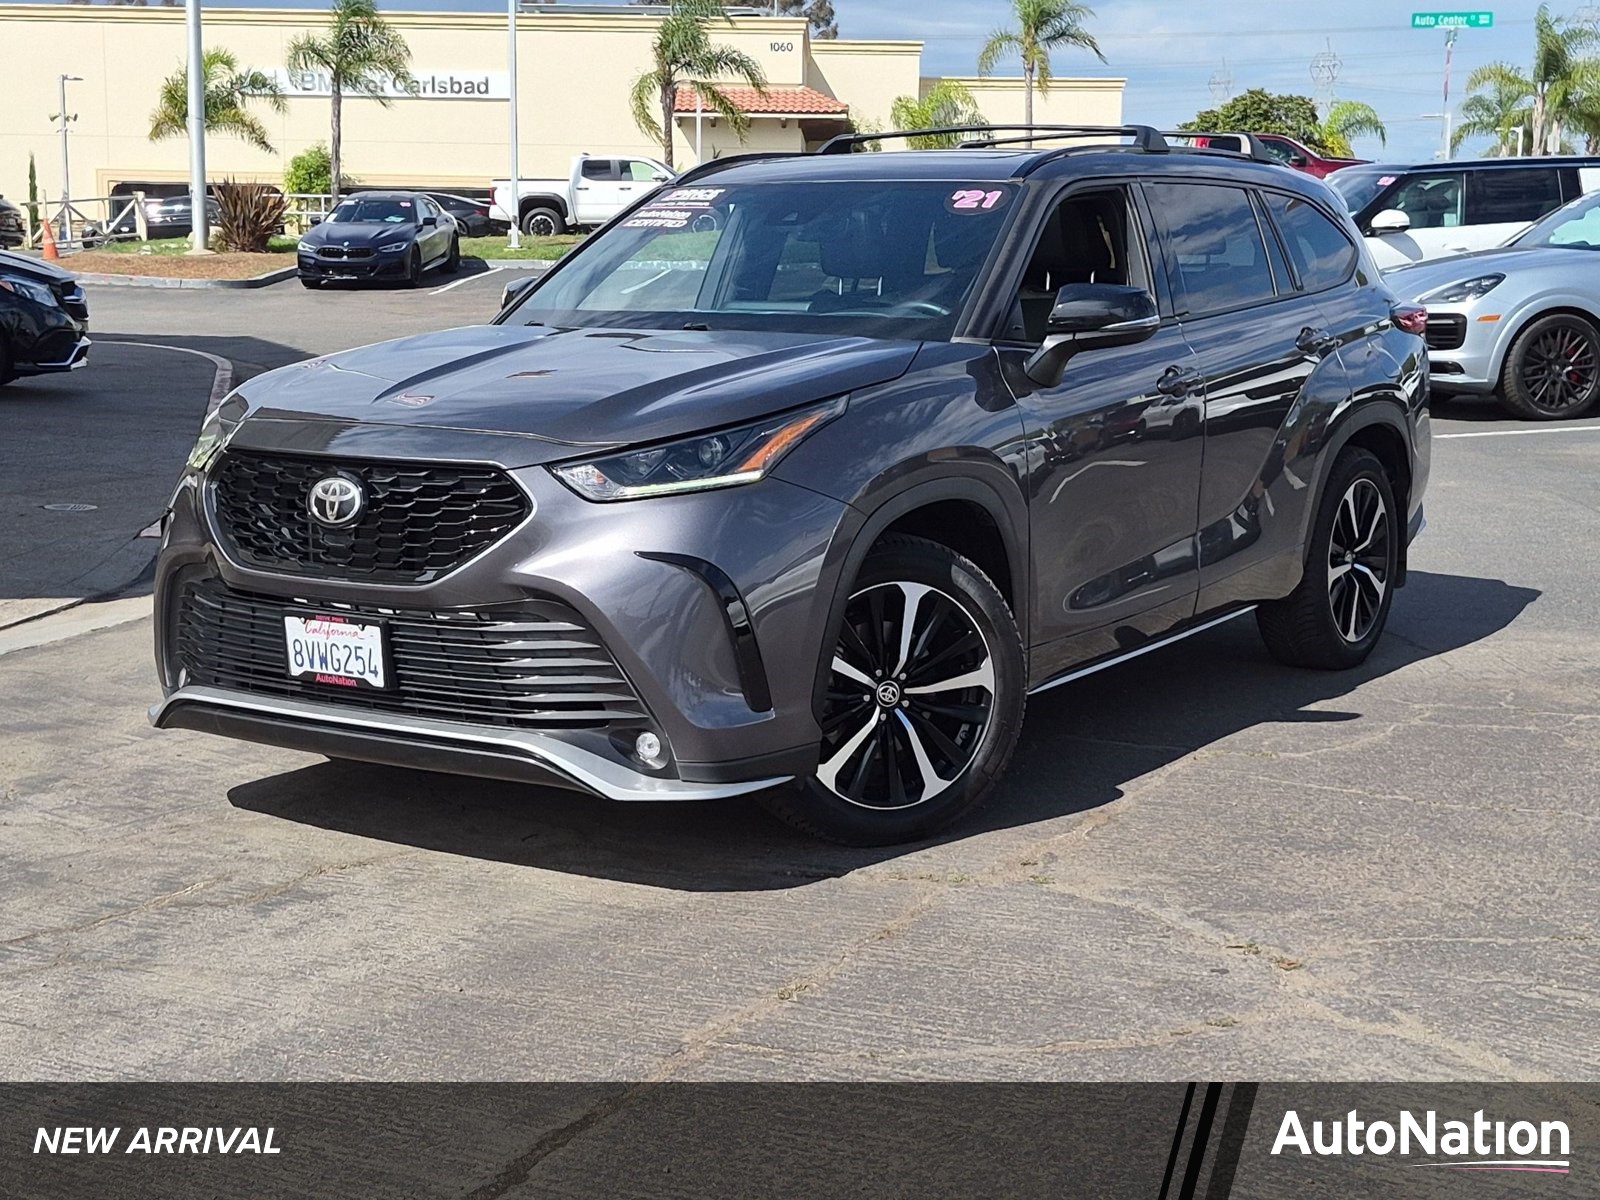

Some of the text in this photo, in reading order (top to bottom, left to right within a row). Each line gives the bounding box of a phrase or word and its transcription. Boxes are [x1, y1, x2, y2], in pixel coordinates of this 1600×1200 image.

[1415, 14, 1436, 25] Auto
[1438, 14, 1468, 25] Center
[770, 42, 794, 52] 1060
[392, 75, 489, 95] Carlsbad
[304, 619, 364, 640] California
[293, 638, 379, 678] 8VWG254
[315, 673, 358, 687] AutoNation
